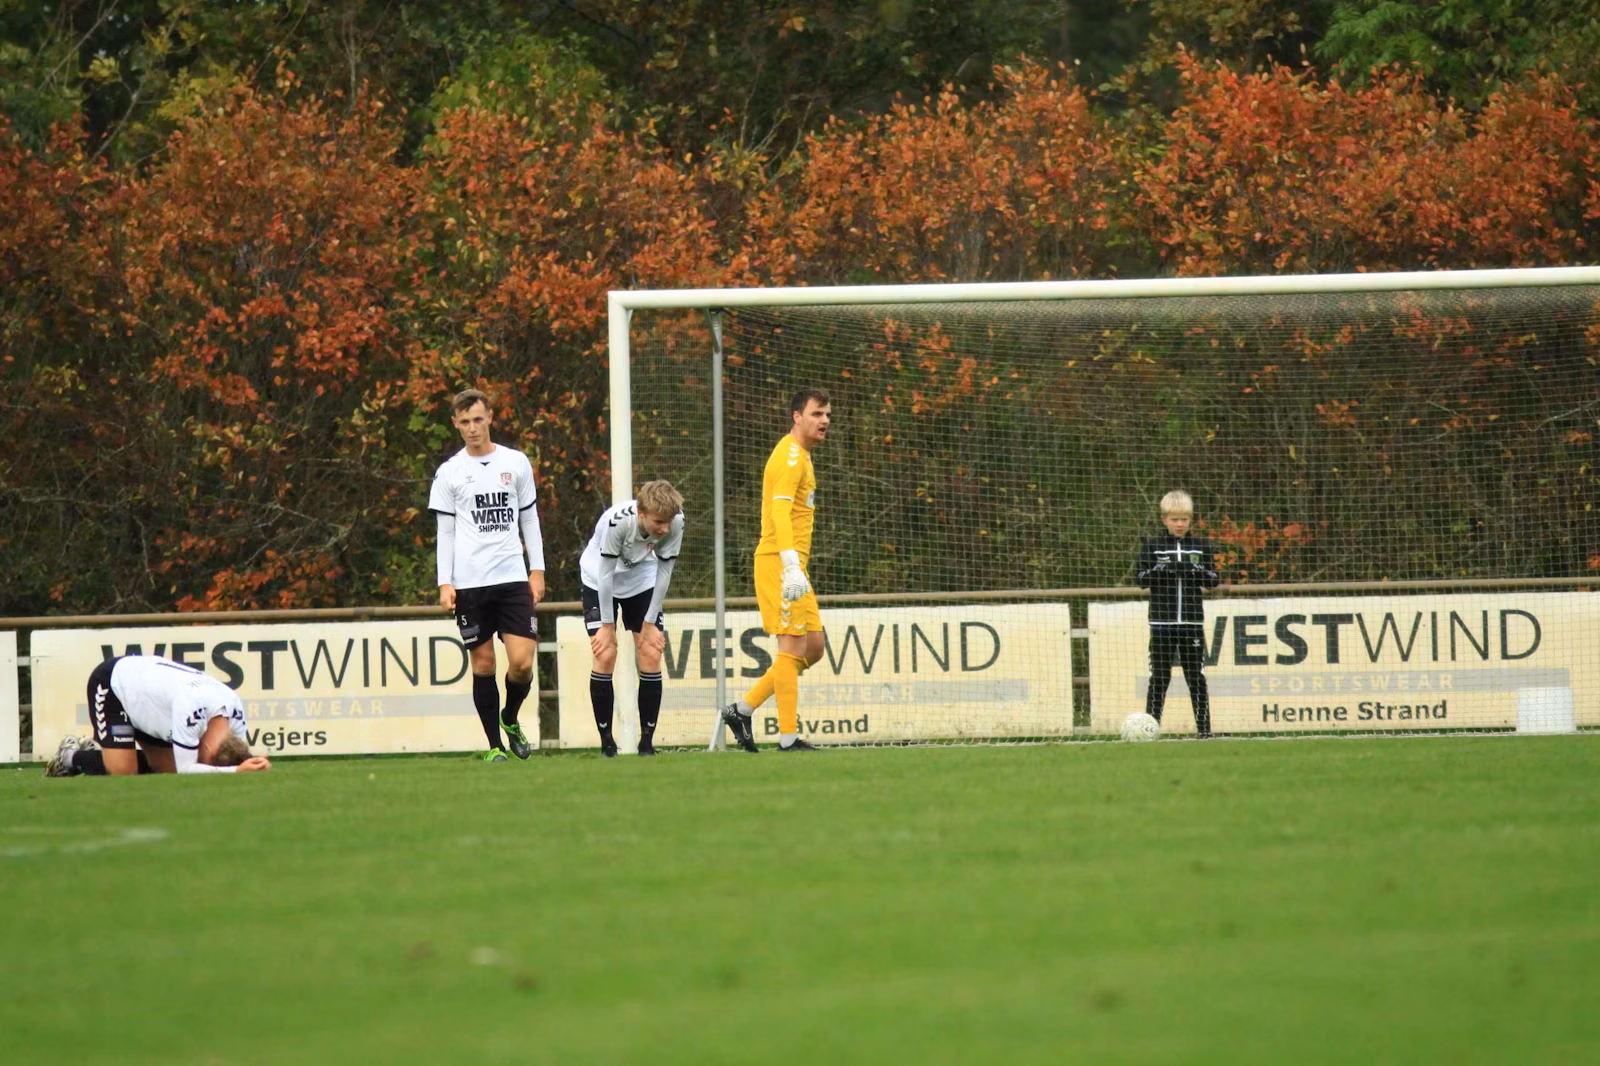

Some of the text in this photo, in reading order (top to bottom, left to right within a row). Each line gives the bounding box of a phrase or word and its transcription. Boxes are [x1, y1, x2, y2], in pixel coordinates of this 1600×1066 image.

[475, 492, 508, 508] BLUE
[471, 508, 514, 524] WATER
[479, 524, 510, 533] SHIPPING
[461, 614, 468, 626] 5
[663, 622, 1001, 680] ESWIND
[810, 681, 915, 701] SWEAR
[1250, 673, 1454, 695] SPORTSWEAR
[247, 699, 384, 719] RTSWEAR
[1262, 699, 1448, 723] Henne Strand
[764, 713, 869, 736] Bvand
[245, 726, 328, 751] Vejers
